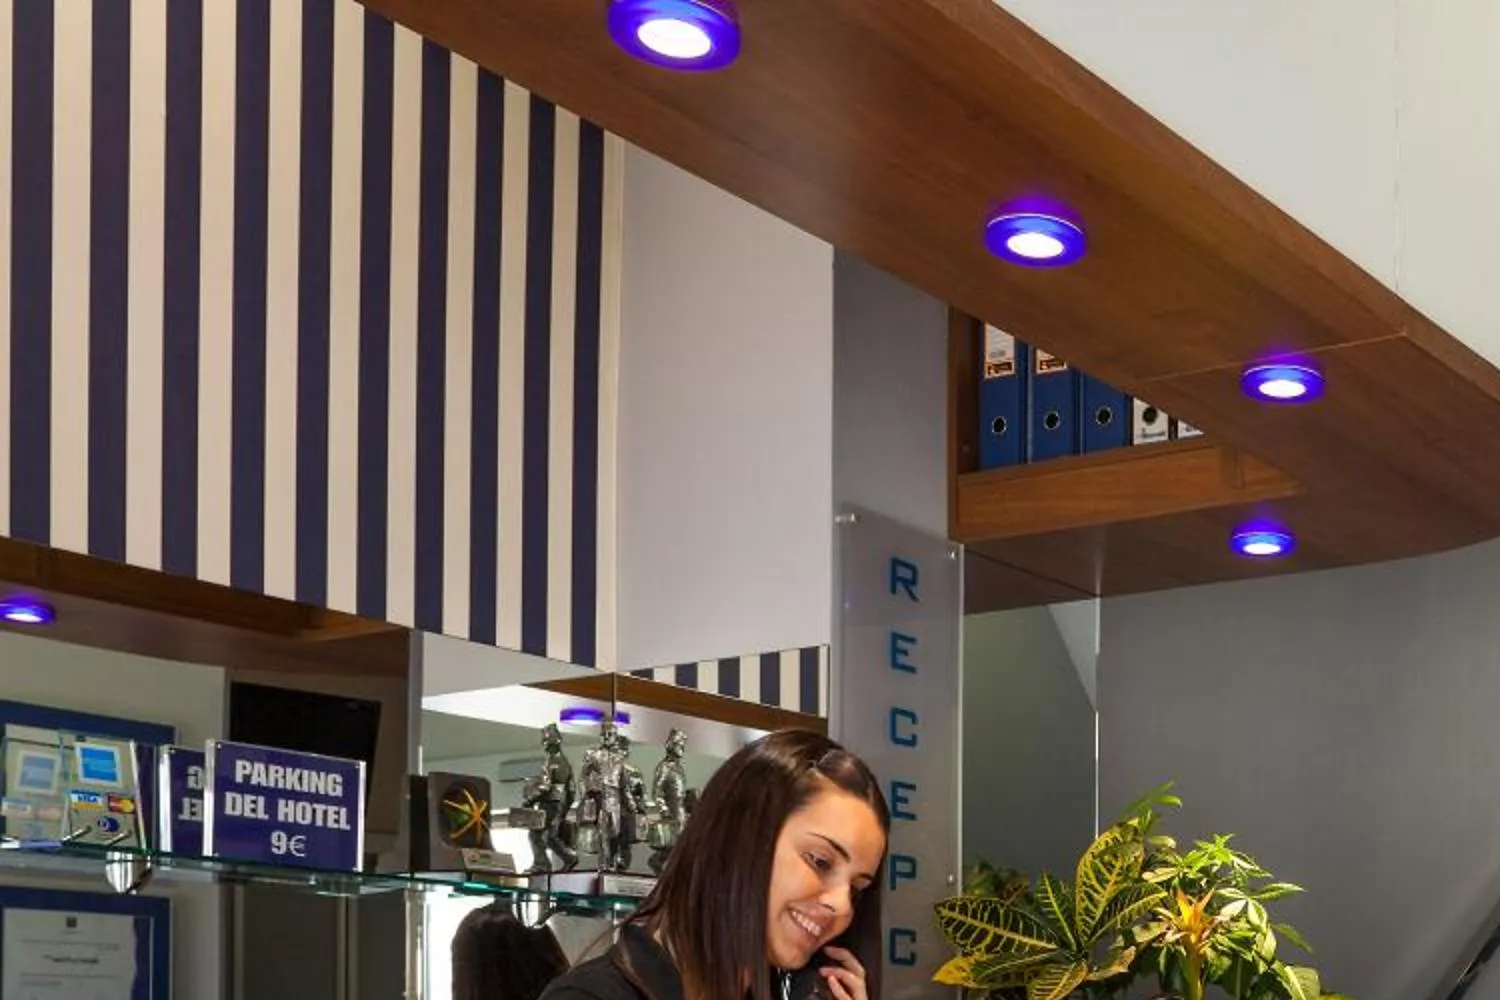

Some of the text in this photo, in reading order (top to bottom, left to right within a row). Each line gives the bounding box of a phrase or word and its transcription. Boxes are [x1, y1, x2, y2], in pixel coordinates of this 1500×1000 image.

[235, 759, 343, 797] PARKING
[224, 791, 270, 820] DEL
[277, 797, 351, 830] HOTEL
[270, 829, 308, 858] 9€
